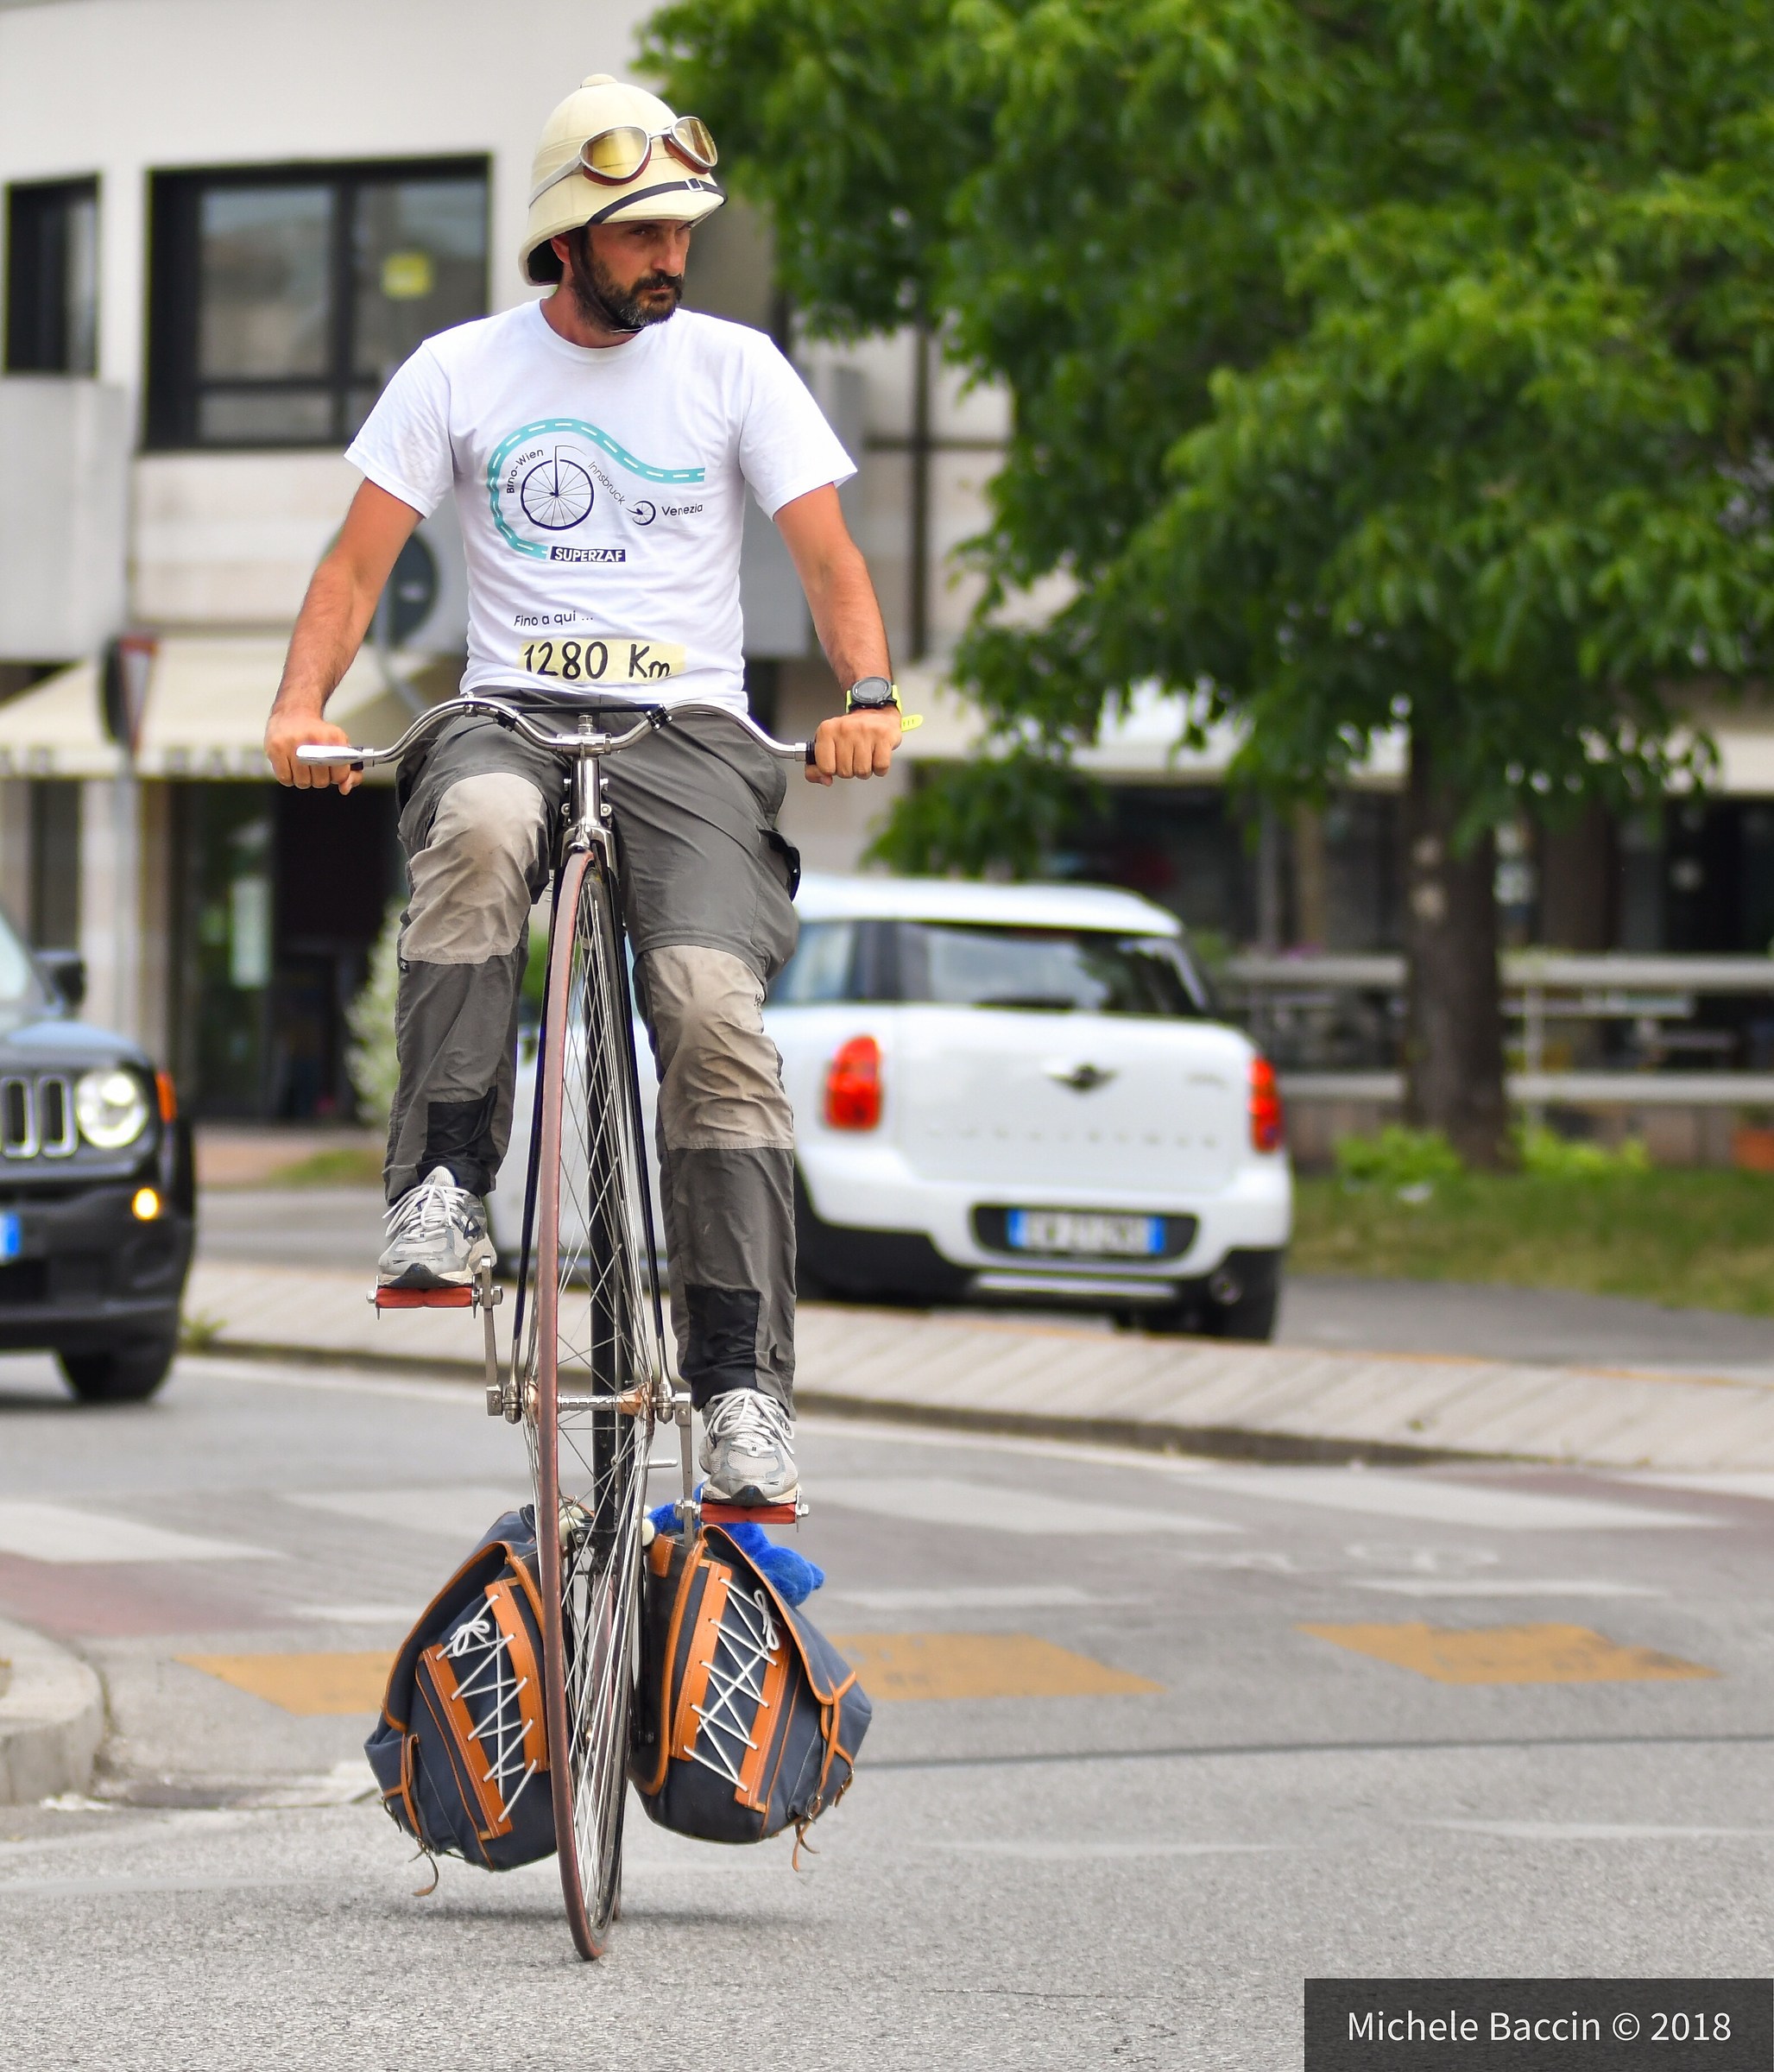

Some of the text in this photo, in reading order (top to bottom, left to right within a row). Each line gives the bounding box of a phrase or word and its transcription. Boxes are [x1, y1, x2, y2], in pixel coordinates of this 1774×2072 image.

[506, 449, 544, 494] Brno-Wien
[588, 461, 626, 505] Innsbruck
[661, 502, 704, 516] Venezia
[553, 547, 623, 562] SUPERZAF
[514, 615, 539, 627] Fino
[541, 616, 550, 625] a
[553, 610, 577, 625] qui
[524, 641, 671, 680] 1280 Km
